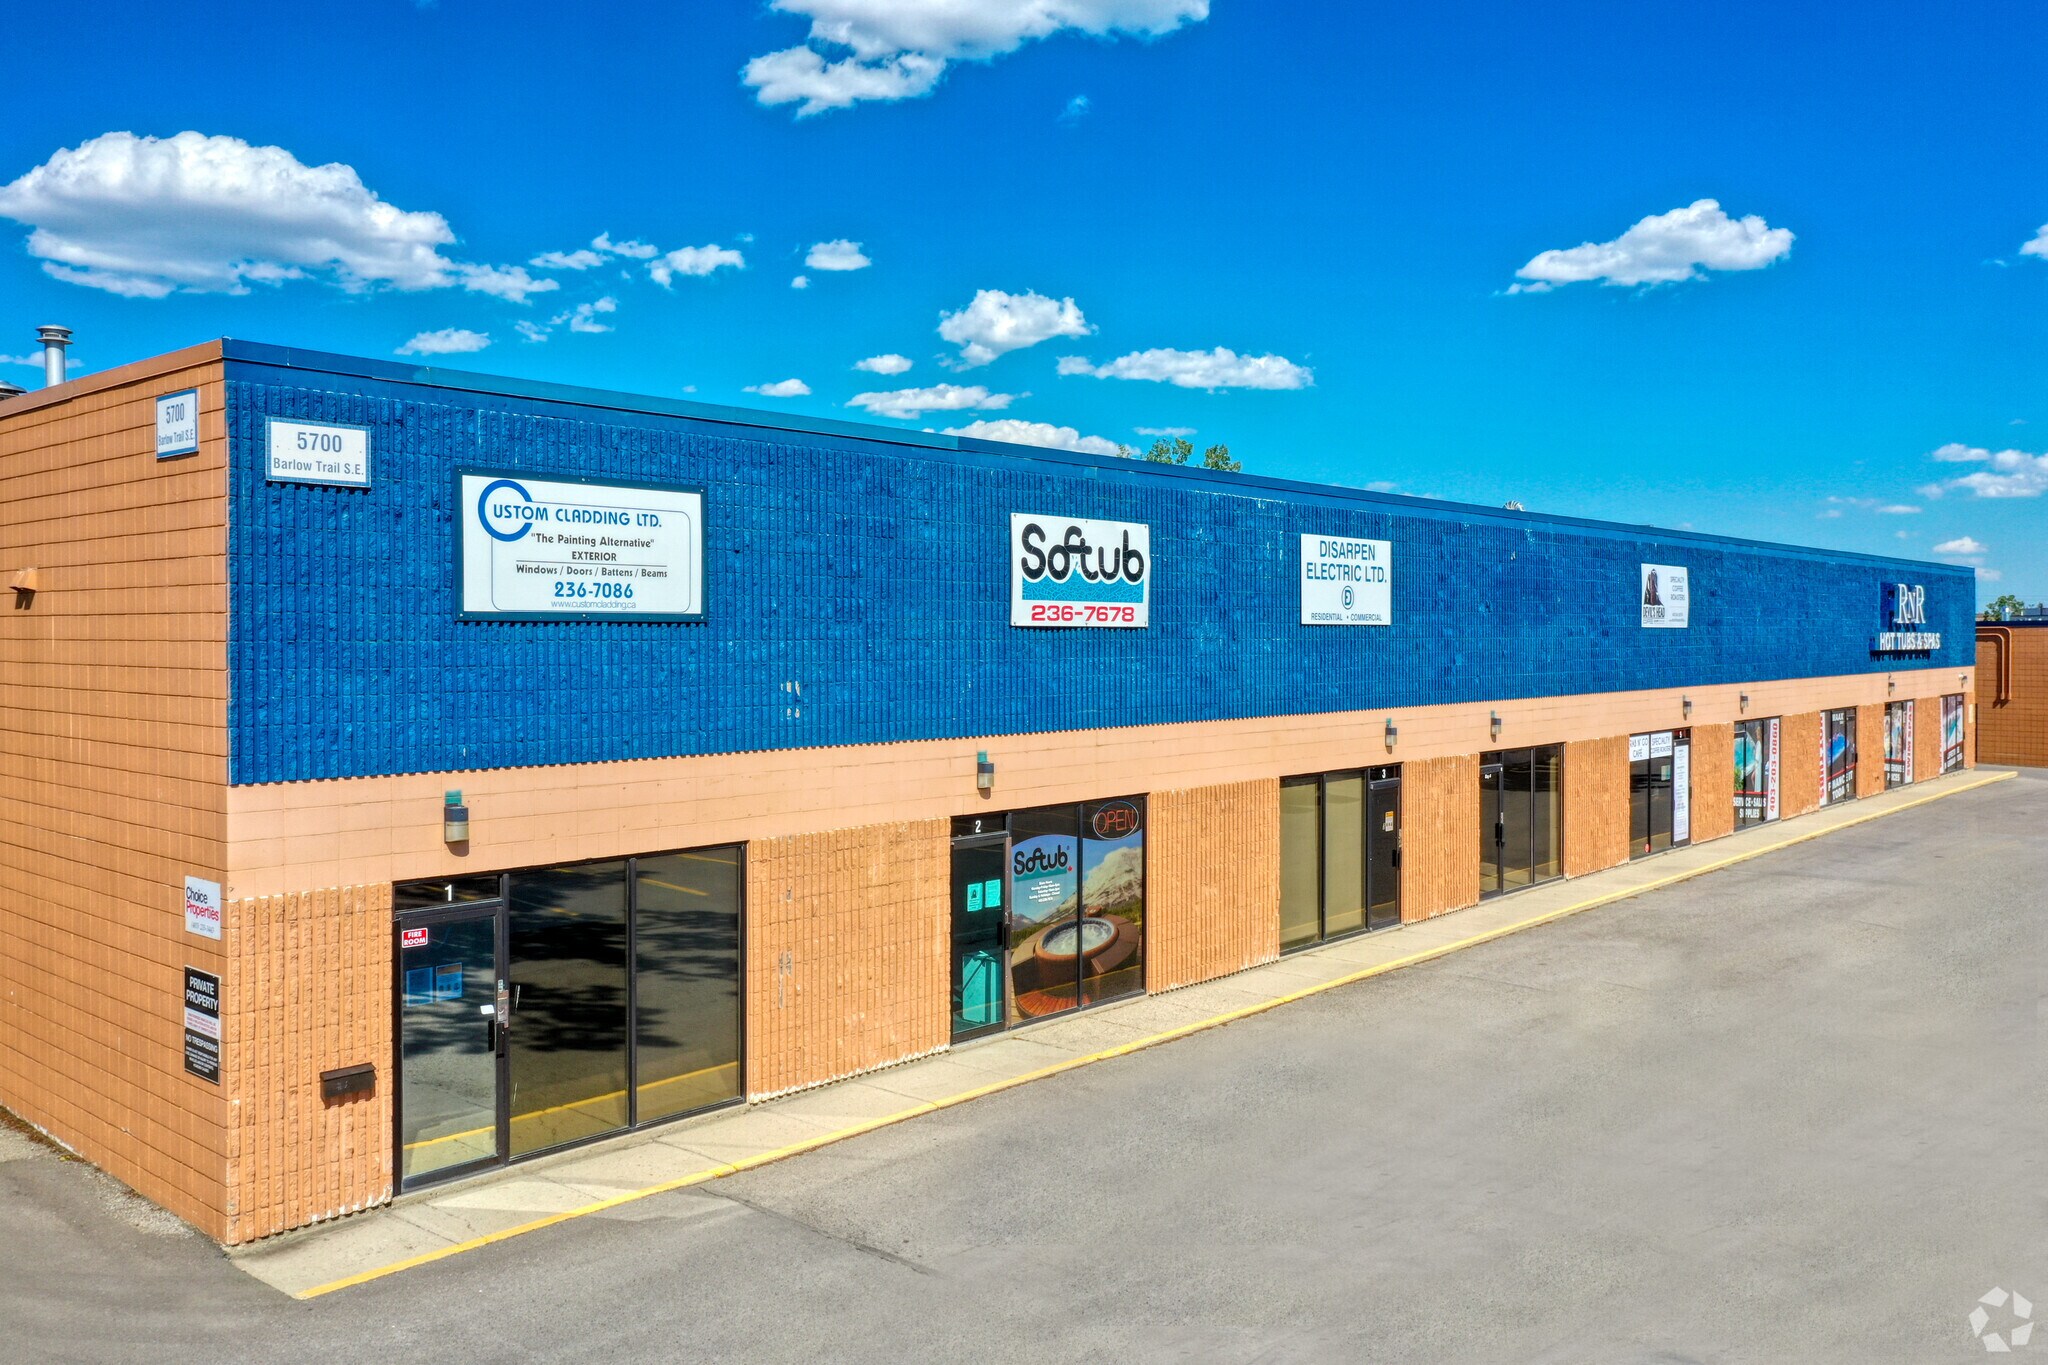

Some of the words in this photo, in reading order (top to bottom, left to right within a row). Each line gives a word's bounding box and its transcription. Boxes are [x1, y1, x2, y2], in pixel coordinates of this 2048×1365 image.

[165, 402, 185, 425] 5700
[158, 432, 173, 446] Barlow
[173, 430, 185, 444] Trail
[185, 428, 195, 442] S.E.
[297, 431, 342, 453] 5700
[273, 457, 312, 472] Barlow
[314, 460, 340, 474] Trail
[343, 464, 364, 477] S.E.
[478, 479, 549, 542] CUSTOM
[555, 508, 631, 526] CLADDING
[636, 513, 662, 528] LTD.
[557, 534, 596, 548] Painting
[1319, 540, 1376, 561] DISARPEN
[571, 551, 617, 562] EXTERIOR
[1021, 523, 1145, 583] Softub
[515, 564, 558, 576] Windows
[566, 566, 593, 577] Doors
[600, 567, 633, 578] Battens
[640, 568, 668, 578] Beams
[1306, 562, 1362, 582] ELECTRIC
[1365, 566, 1387, 583] LTD.
[554, 581, 634, 599] 236-7086
[550, 600, 637, 611] www.customcladding.ca
[1031, 605, 1135, 622] 236-7678
[1310, 612, 1343, 621] RESIDENTIAL
[1350, 613, 1382, 622] COMMERCIAL
[1879, 632, 1895, 651] HOT
[1896, 632, 1916, 651] TUBS
[1923, 632, 1941, 650] SPAS
[1381, 768, 1387, 779] 3
[975, 820, 982, 833] 2
[1095, 808, 1134, 834] OPEN
[1013, 844, 1068, 876] Softub
[185, 886, 208, 905] Choice
[444, 884, 453, 902] 1
[186, 899, 219, 921] Properties
[403, 937, 426, 946] ROOM
[407, 930, 423, 939] FIRE
[189, 976, 215, 996] PRIVATE
[186, 989, 218, 1011] PROPERTY
[192, 1035, 218, 1054] TRESPASSING
